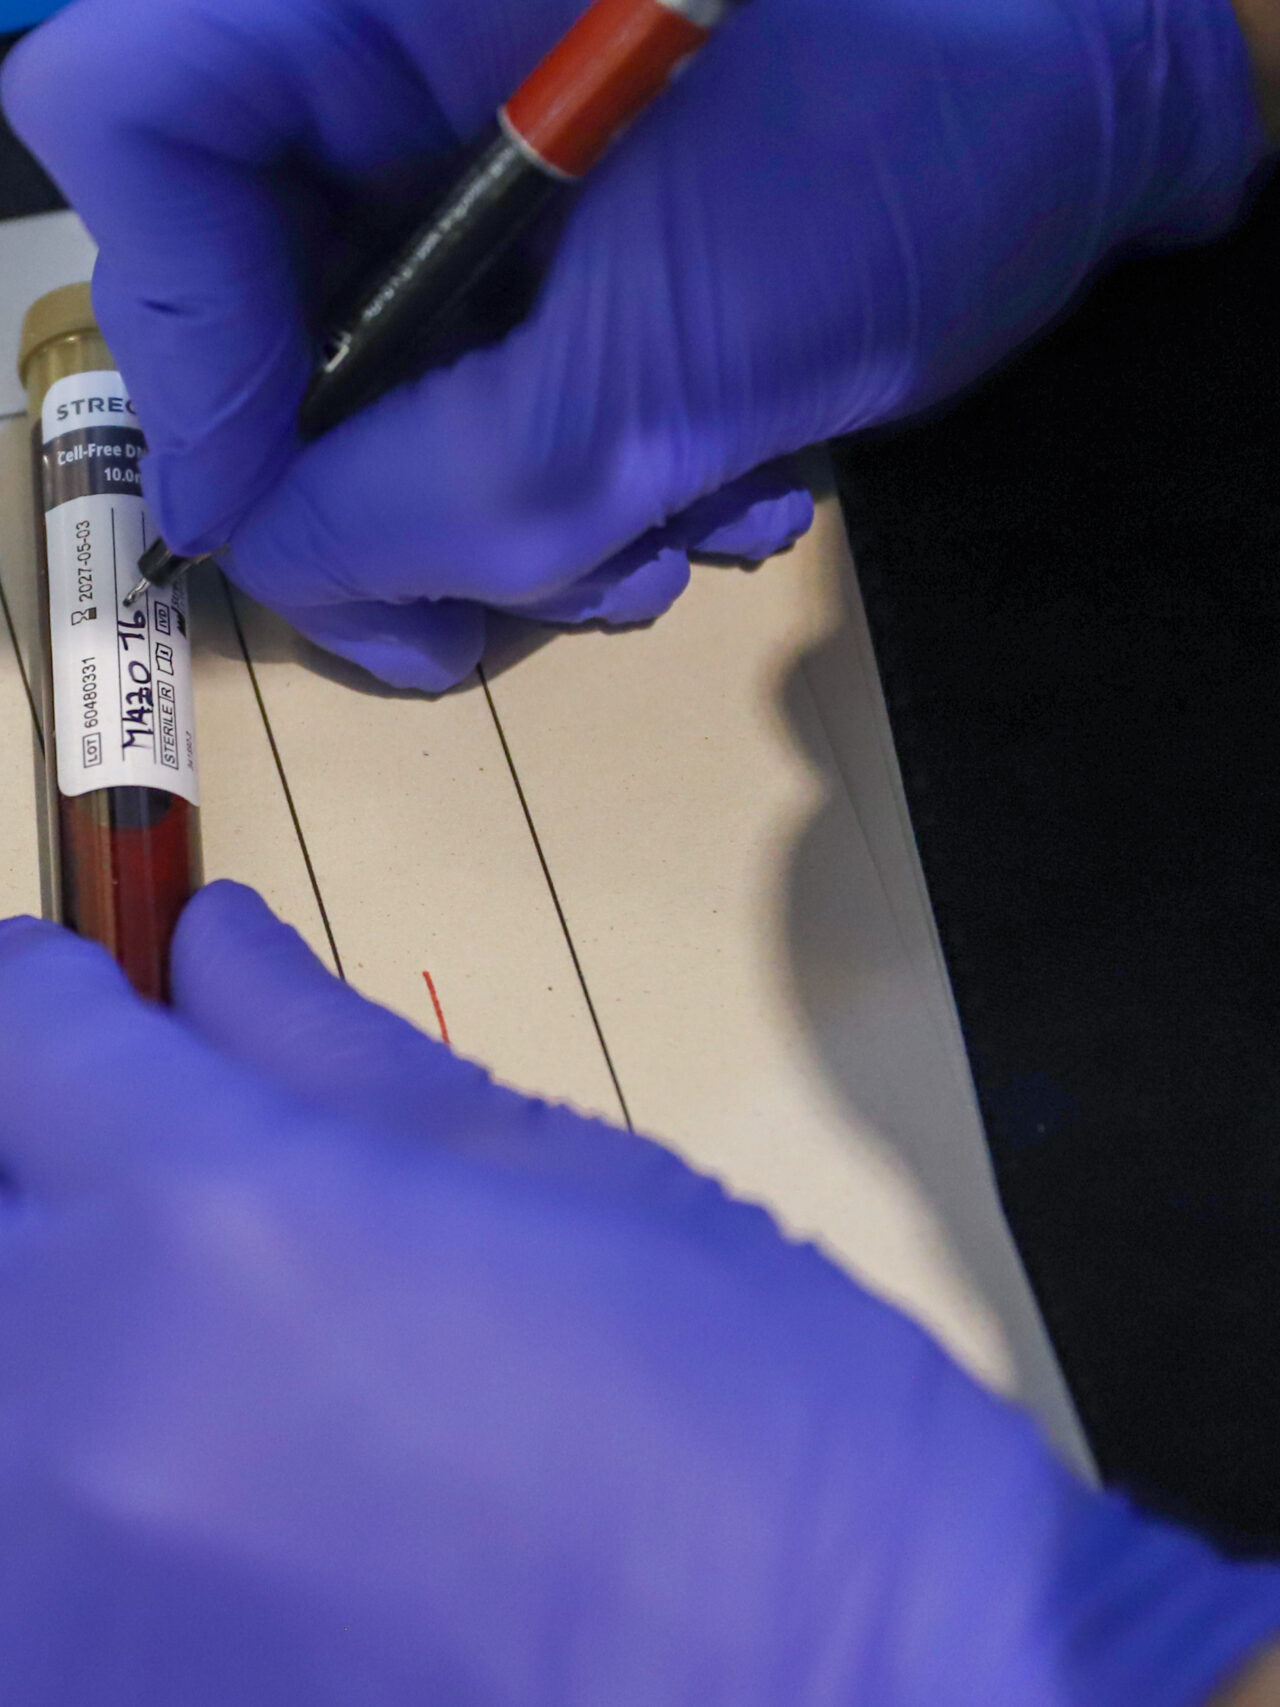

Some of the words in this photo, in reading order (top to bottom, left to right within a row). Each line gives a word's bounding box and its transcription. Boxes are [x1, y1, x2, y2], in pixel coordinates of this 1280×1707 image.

[56, 396, 137, 421] STREC
[57, 443, 122, 467] Cell-Free
[125, 444, 148, 459] DN
[76, 519, 92, 603] 2027-05-03
[158, 609, 168, 628] IVD
[81, 656, 99, 729] 60480331
[162, 705, 176, 765] STERILE
[86, 736, 100, 766] LOT
